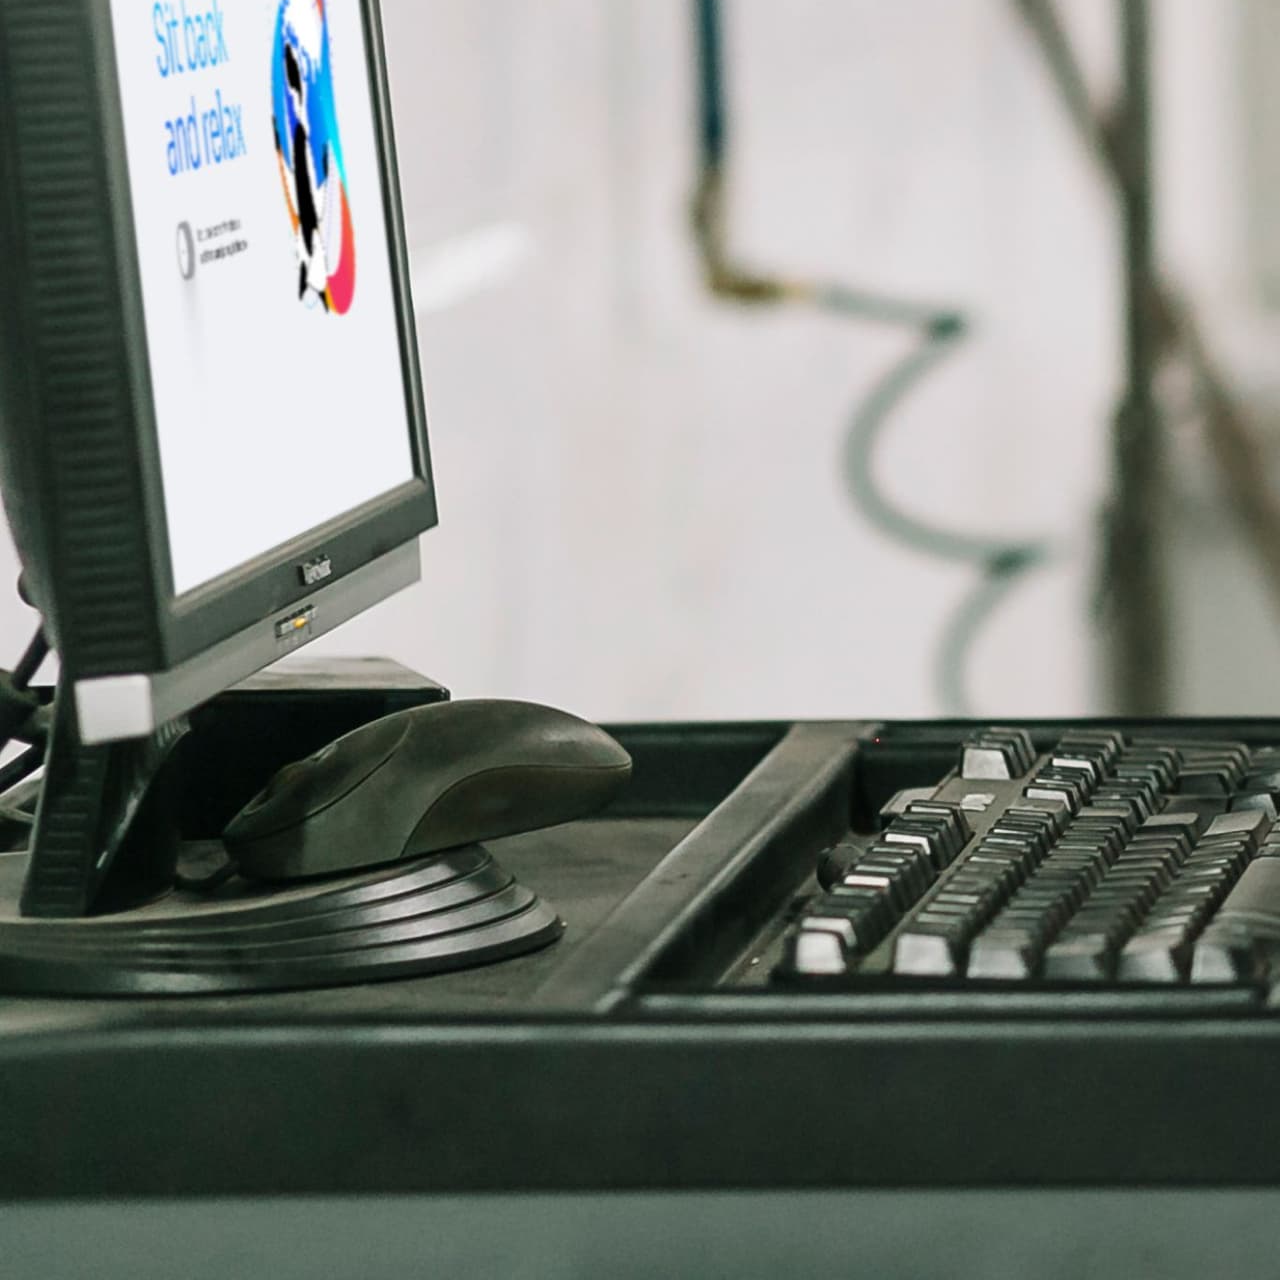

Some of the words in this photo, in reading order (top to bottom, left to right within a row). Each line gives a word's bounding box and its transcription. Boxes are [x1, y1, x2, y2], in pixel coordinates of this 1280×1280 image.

[152, 1, 183, 78] Sit
[165, 95, 201, 175] and
[202, 88, 247, 165] relax
